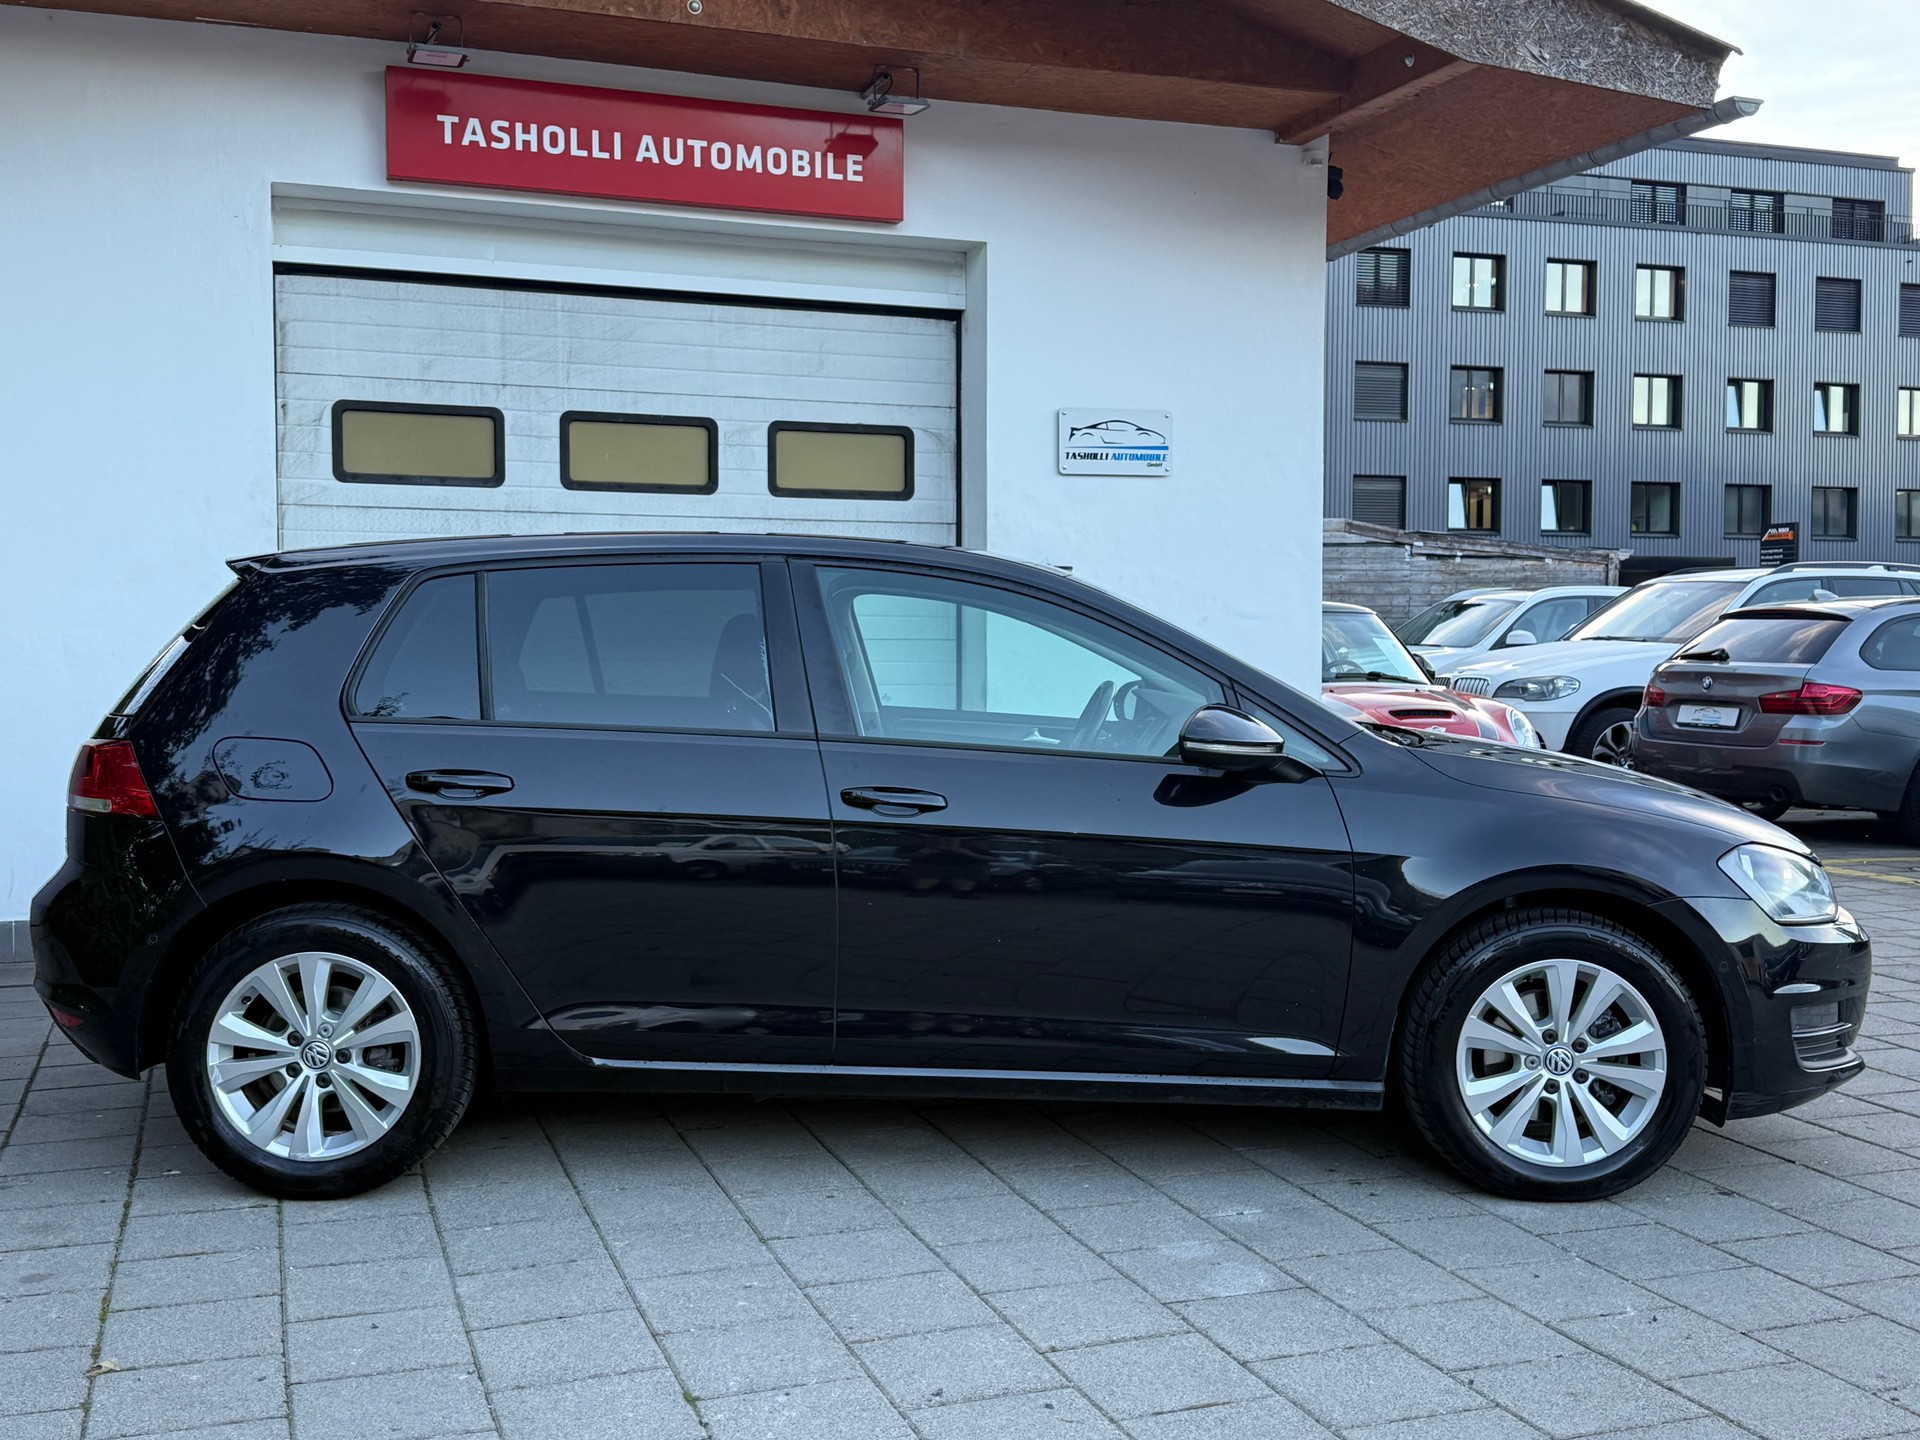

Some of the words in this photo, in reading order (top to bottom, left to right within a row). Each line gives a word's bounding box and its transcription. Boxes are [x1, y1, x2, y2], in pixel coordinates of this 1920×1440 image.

[437, 115, 621, 161] TASHOLLI
[636, 134, 864, 183] AUTOMOBILE
[1065, 451, 1109, 461] TASHOLLI
[1111, 452, 1168, 462] AUTOMOBILE
